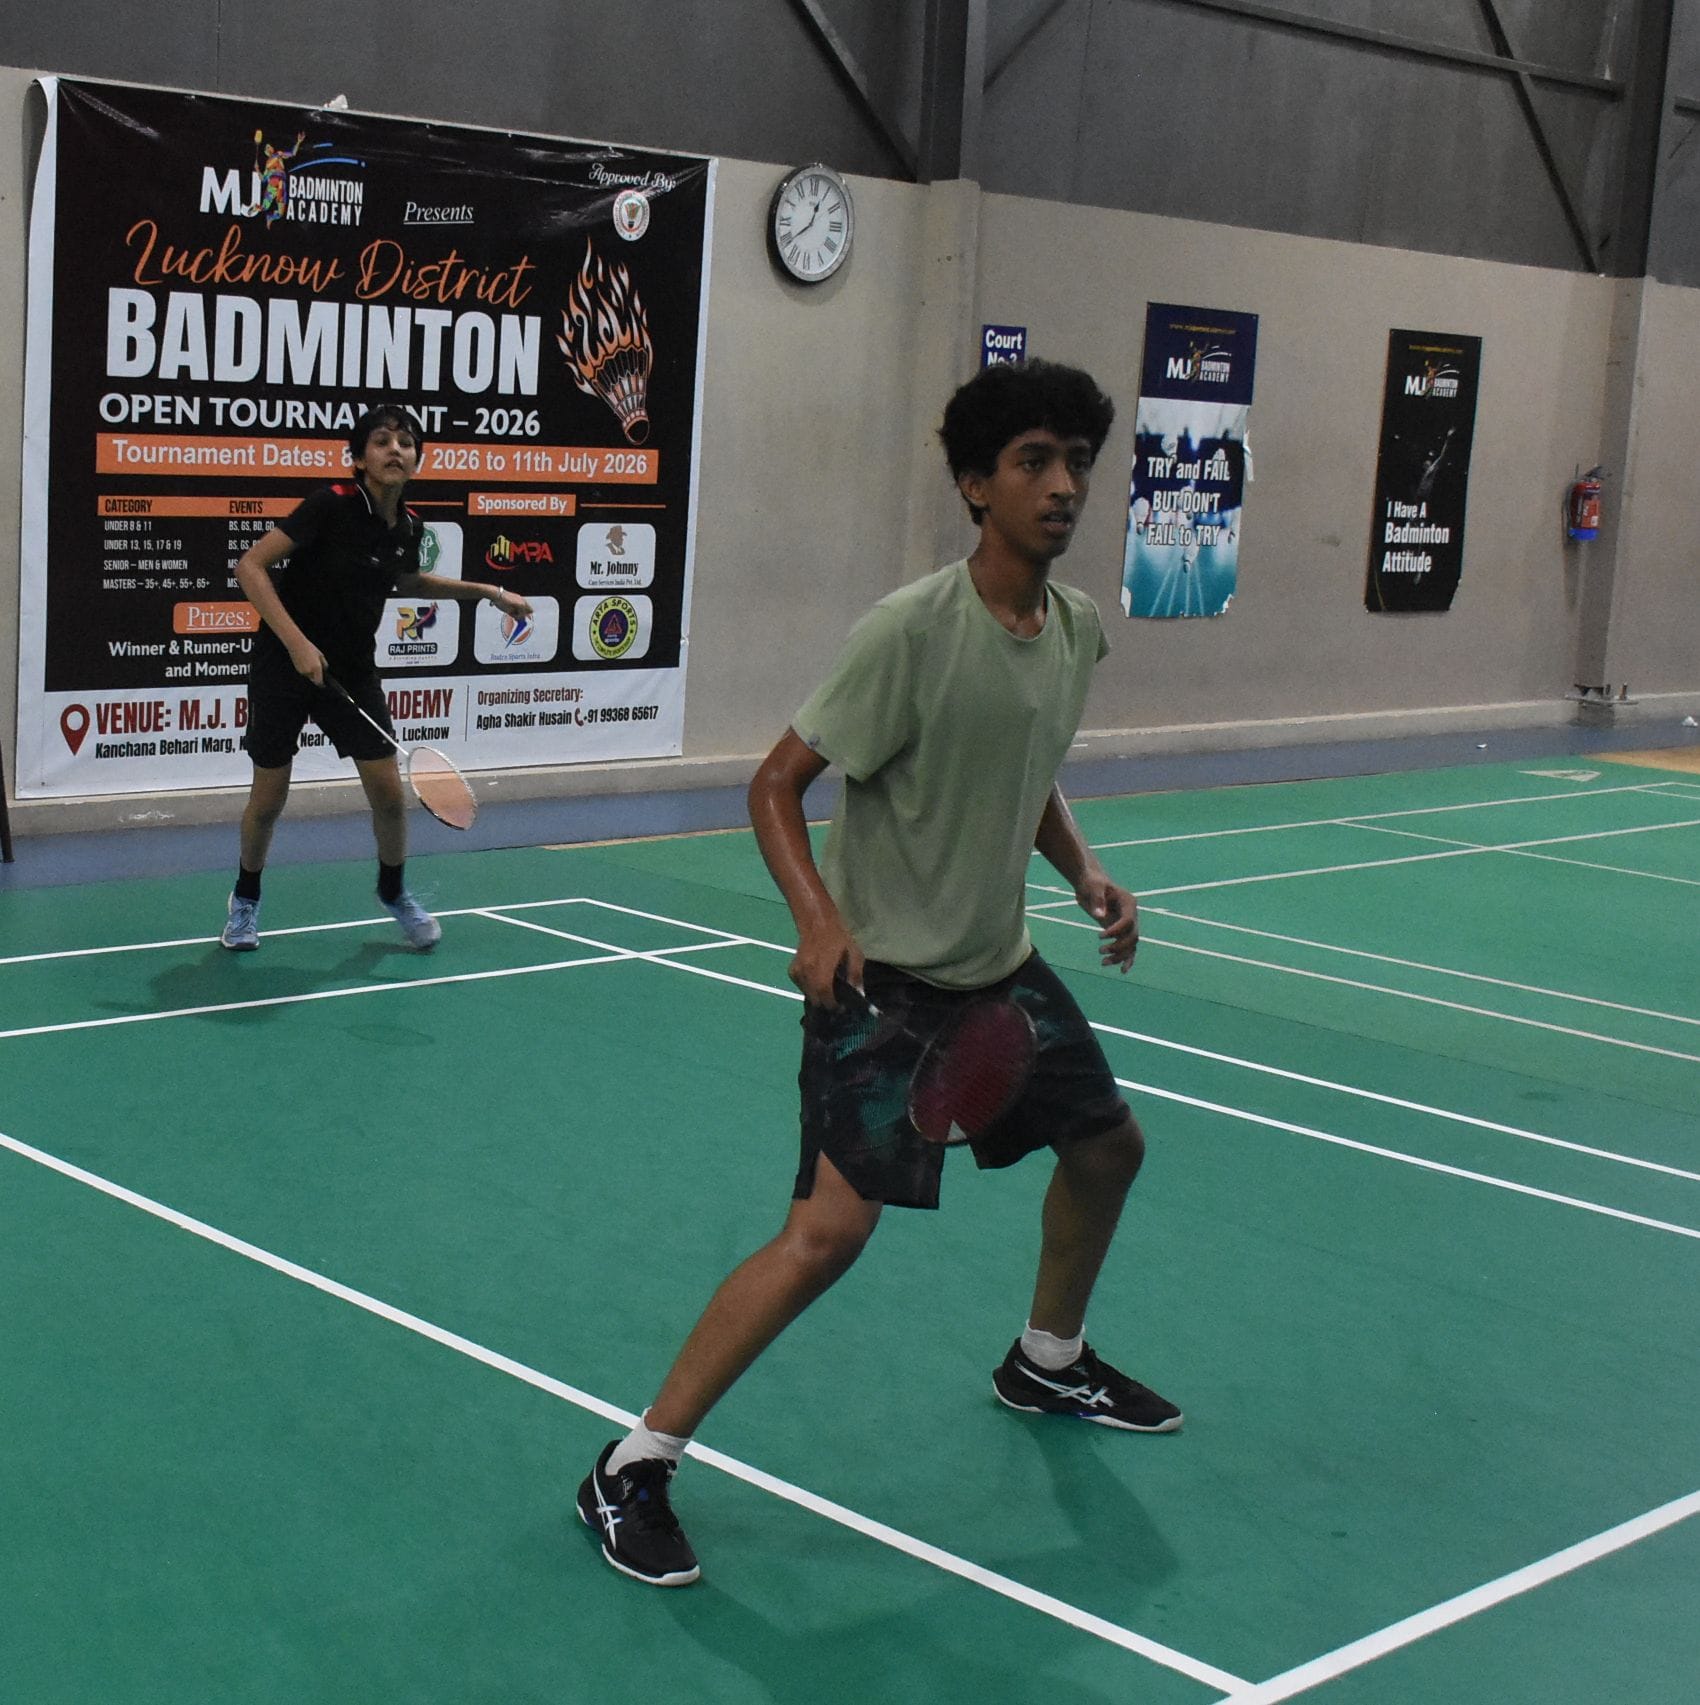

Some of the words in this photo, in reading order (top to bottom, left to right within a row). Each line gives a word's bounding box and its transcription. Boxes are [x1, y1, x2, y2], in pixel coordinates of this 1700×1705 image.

[589, 163, 651, 186] Approved
[200, 166, 261, 217] MJ
[289, 175, 364, 205] BADMINTON
[286, 198, 363, 227] ACADEMY
[403, 201, 474, 223] Presents
[126, 220, 345, 293] Lucknow
[356, 239, 536, 308] District
[106, 287, 541, 396] BADMINTON
[985, 329, 1023, 350] Court
[1166, 357, 1192, 381] MJ
[99, 393, 200, 426] OPEN
[209, 397, 447, 434] TOURNANT
[475, 407, 541, 437] 2026
[112, 439, 255, 465] Tournament
[263, 444, 333, 467] Dates:
[432, 448, 480, 471] 2026
[486, 452, 506, 472] to
[513, 452, 552, 473] 11th
[558, 453, 599, 478] July
[603, 453, 647, 475] 2026
[1147, 457, 1174, 478] TRY
[1176, 459, 1201, 480] and
[1203, 460, 1230, 481] FAIL
[105, 499, 153, 513] CATEGORY
[229, 500, 263, 514] EVENTS
[477, 497, 546, 513] Sponsored
[549, 497, 567, 514] By
[1152, 490, 1180, 513] BUT
[1182, 491, 1221, 514] DON'T
[1387, 501, 1392, 518] I
[1394, 501, 1418, 518] Have
[1419, 501, 1427, 518] A
[104, 521, 129, 531] UNDER
[143, 521, 152, 531] 11
[1146, 523, 1175, 546] FAIL
[1180, 525, 1192, 546] to
[1196, 525, 1221, 546] TRY
[1384, 522, 1450, 543] Badminton
[104, 540, 128, 550] UNDER
[156, 540, 165, 550] 17
[173, 540, 182, 550] 19
[509, 542, 554, 563] MPA
[103, 560, 129, 570] SENIOR
[138, 560, 154, 570] MEN
[161, 560, 188, 570] WOMEN
[590, 561, 603, 576] Mr.
[606, 561, 639, 576] Johnny
[1382, 550, 1433, 573] Attitude
[103, 579, 136, 589] MASTERS
[188, 606, 251, 627] Prizes:
[593, 604, 609, 626] ARYA
[611, 599, 636, 626] SPORTS
[108, 641, 166, 657] Winner
[169, 640, 180, 655] &
[184, 638, 254, 655] Runner-U
[390, 644, 405, 654] RAJ
[407, 643, 436, 654] PRINTS
[165, 663, 191, 678] and
[478, 689, 531, 707] Organizing
[533, 687, 583, 703] Secretary:
[96, 701, 171, 735] VENUE:
[179, 699, 226, 731] M.J.
[476, 714, 502, 730] Agha
[505, 711, 536, 728] Shakir
[539, 710, 572, 726] Husain
[600, 707, 629, 723] 99368
[631, 706, 659, 721] 65617
[300, 732, 325, 747] Near
[402, 725, 450, 742] Lucknow
[95, 741, 156, 759] Kanchana
[160, 737, 198, 756] Behari
[201, 736, 235, 754] Marg,
